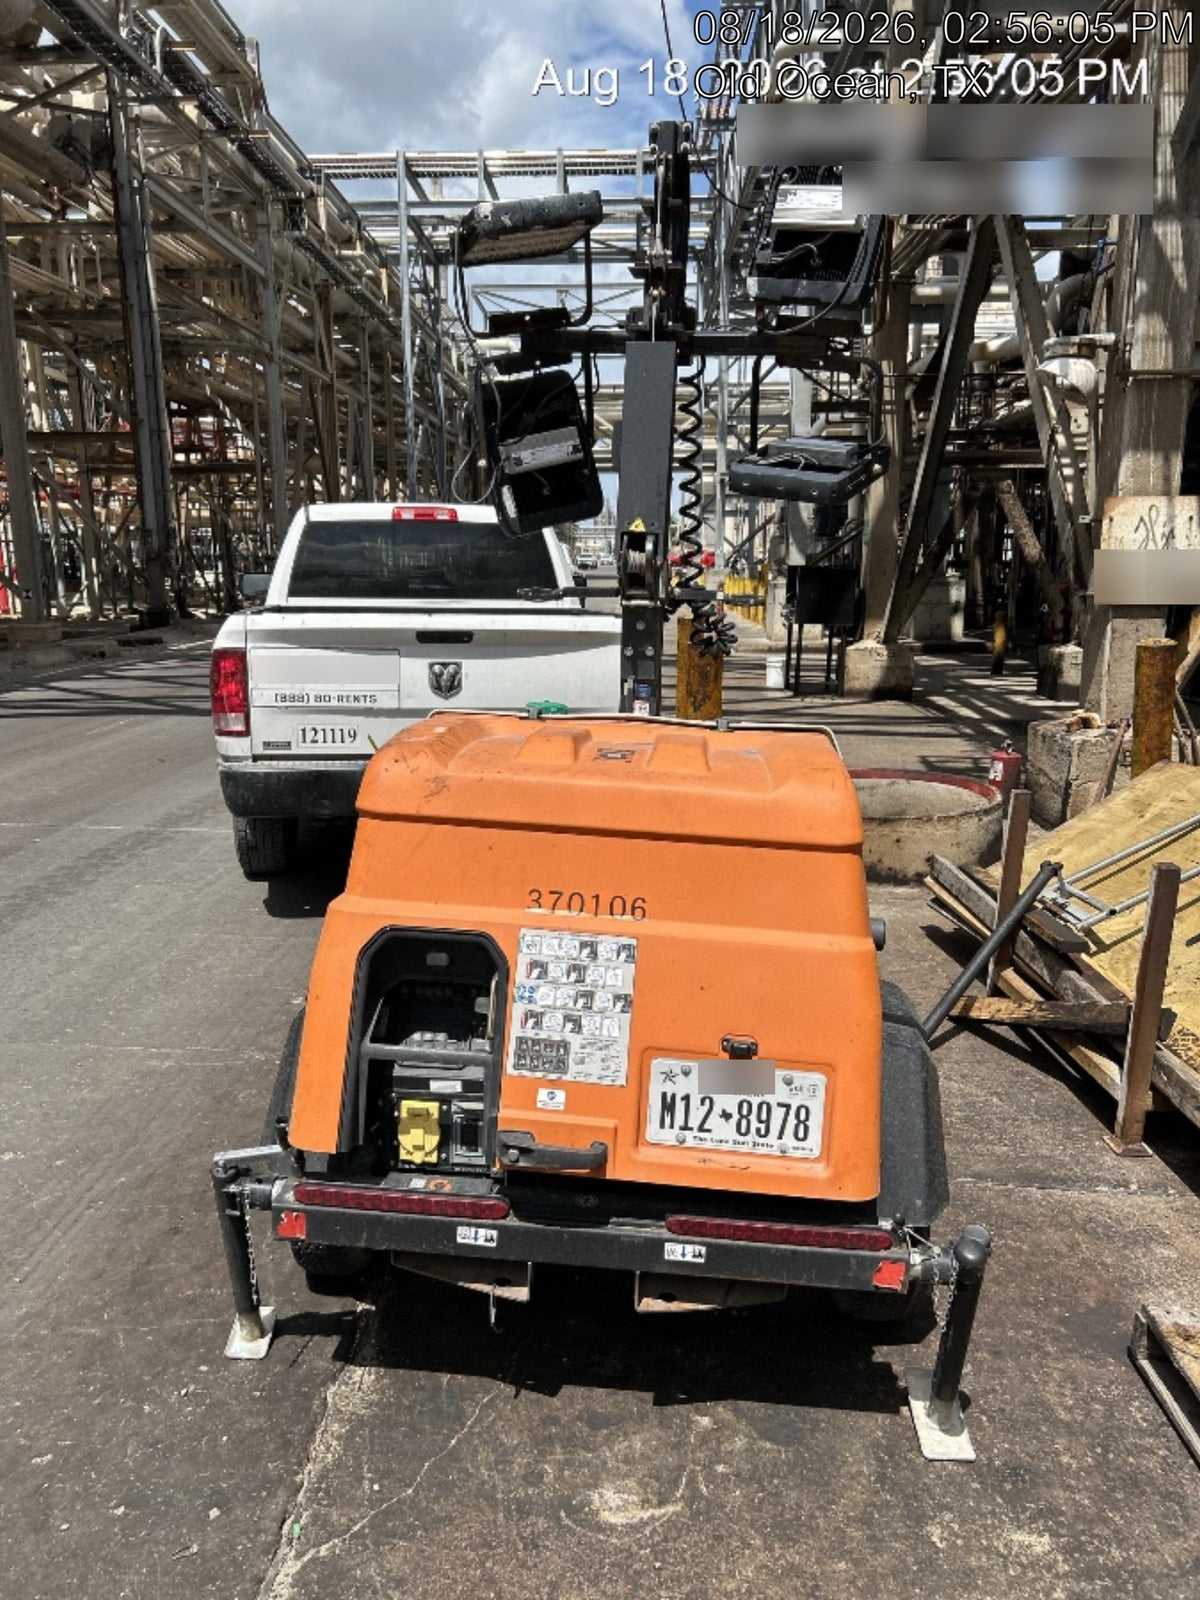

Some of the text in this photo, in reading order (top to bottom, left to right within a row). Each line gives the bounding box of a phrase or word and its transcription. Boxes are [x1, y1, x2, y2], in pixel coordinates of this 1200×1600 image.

[274, 692, 310, 704] (888)
[299, 727, 357, 744] 121119
[526, 888, 647, 921] 370106
